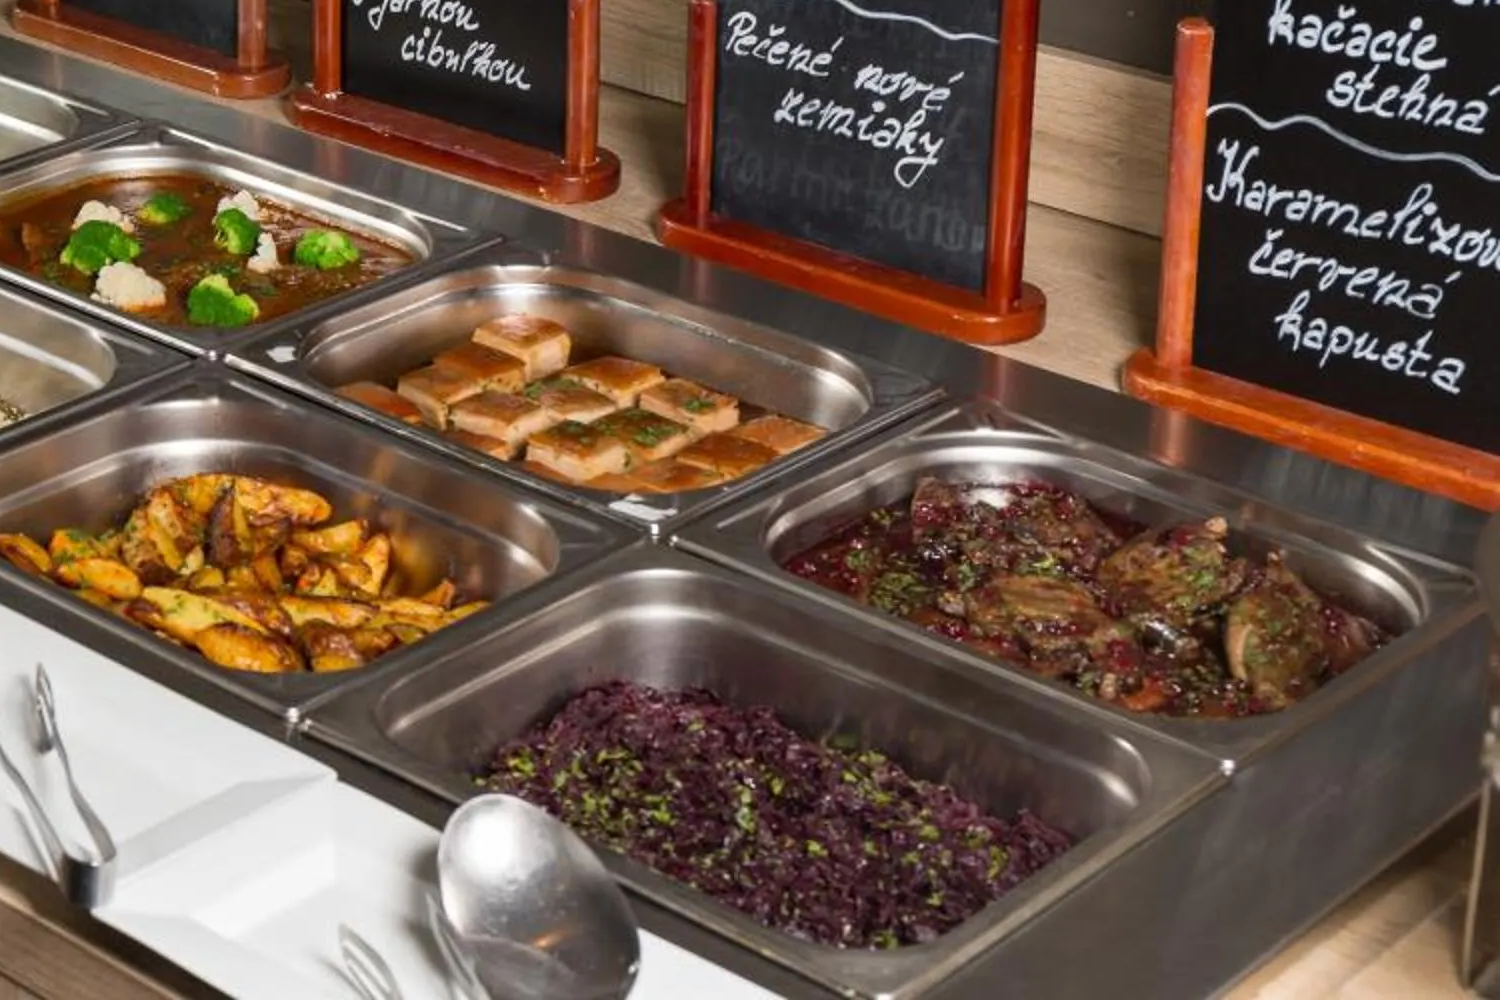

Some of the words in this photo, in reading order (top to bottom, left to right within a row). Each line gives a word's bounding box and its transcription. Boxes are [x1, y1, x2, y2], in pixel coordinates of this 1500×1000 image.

[725, 11, 844, 78] Pečené
[854, 64, 965, 111] nové
[1326, 63, 1500, 135] stehná
[773, 88, 944, 188] zemiaky
[1207, 138, 1500, 270] Karamelizov
[1249, 229, 1462, 320] červená
[1275, 290, 1466, 395] kapusta
